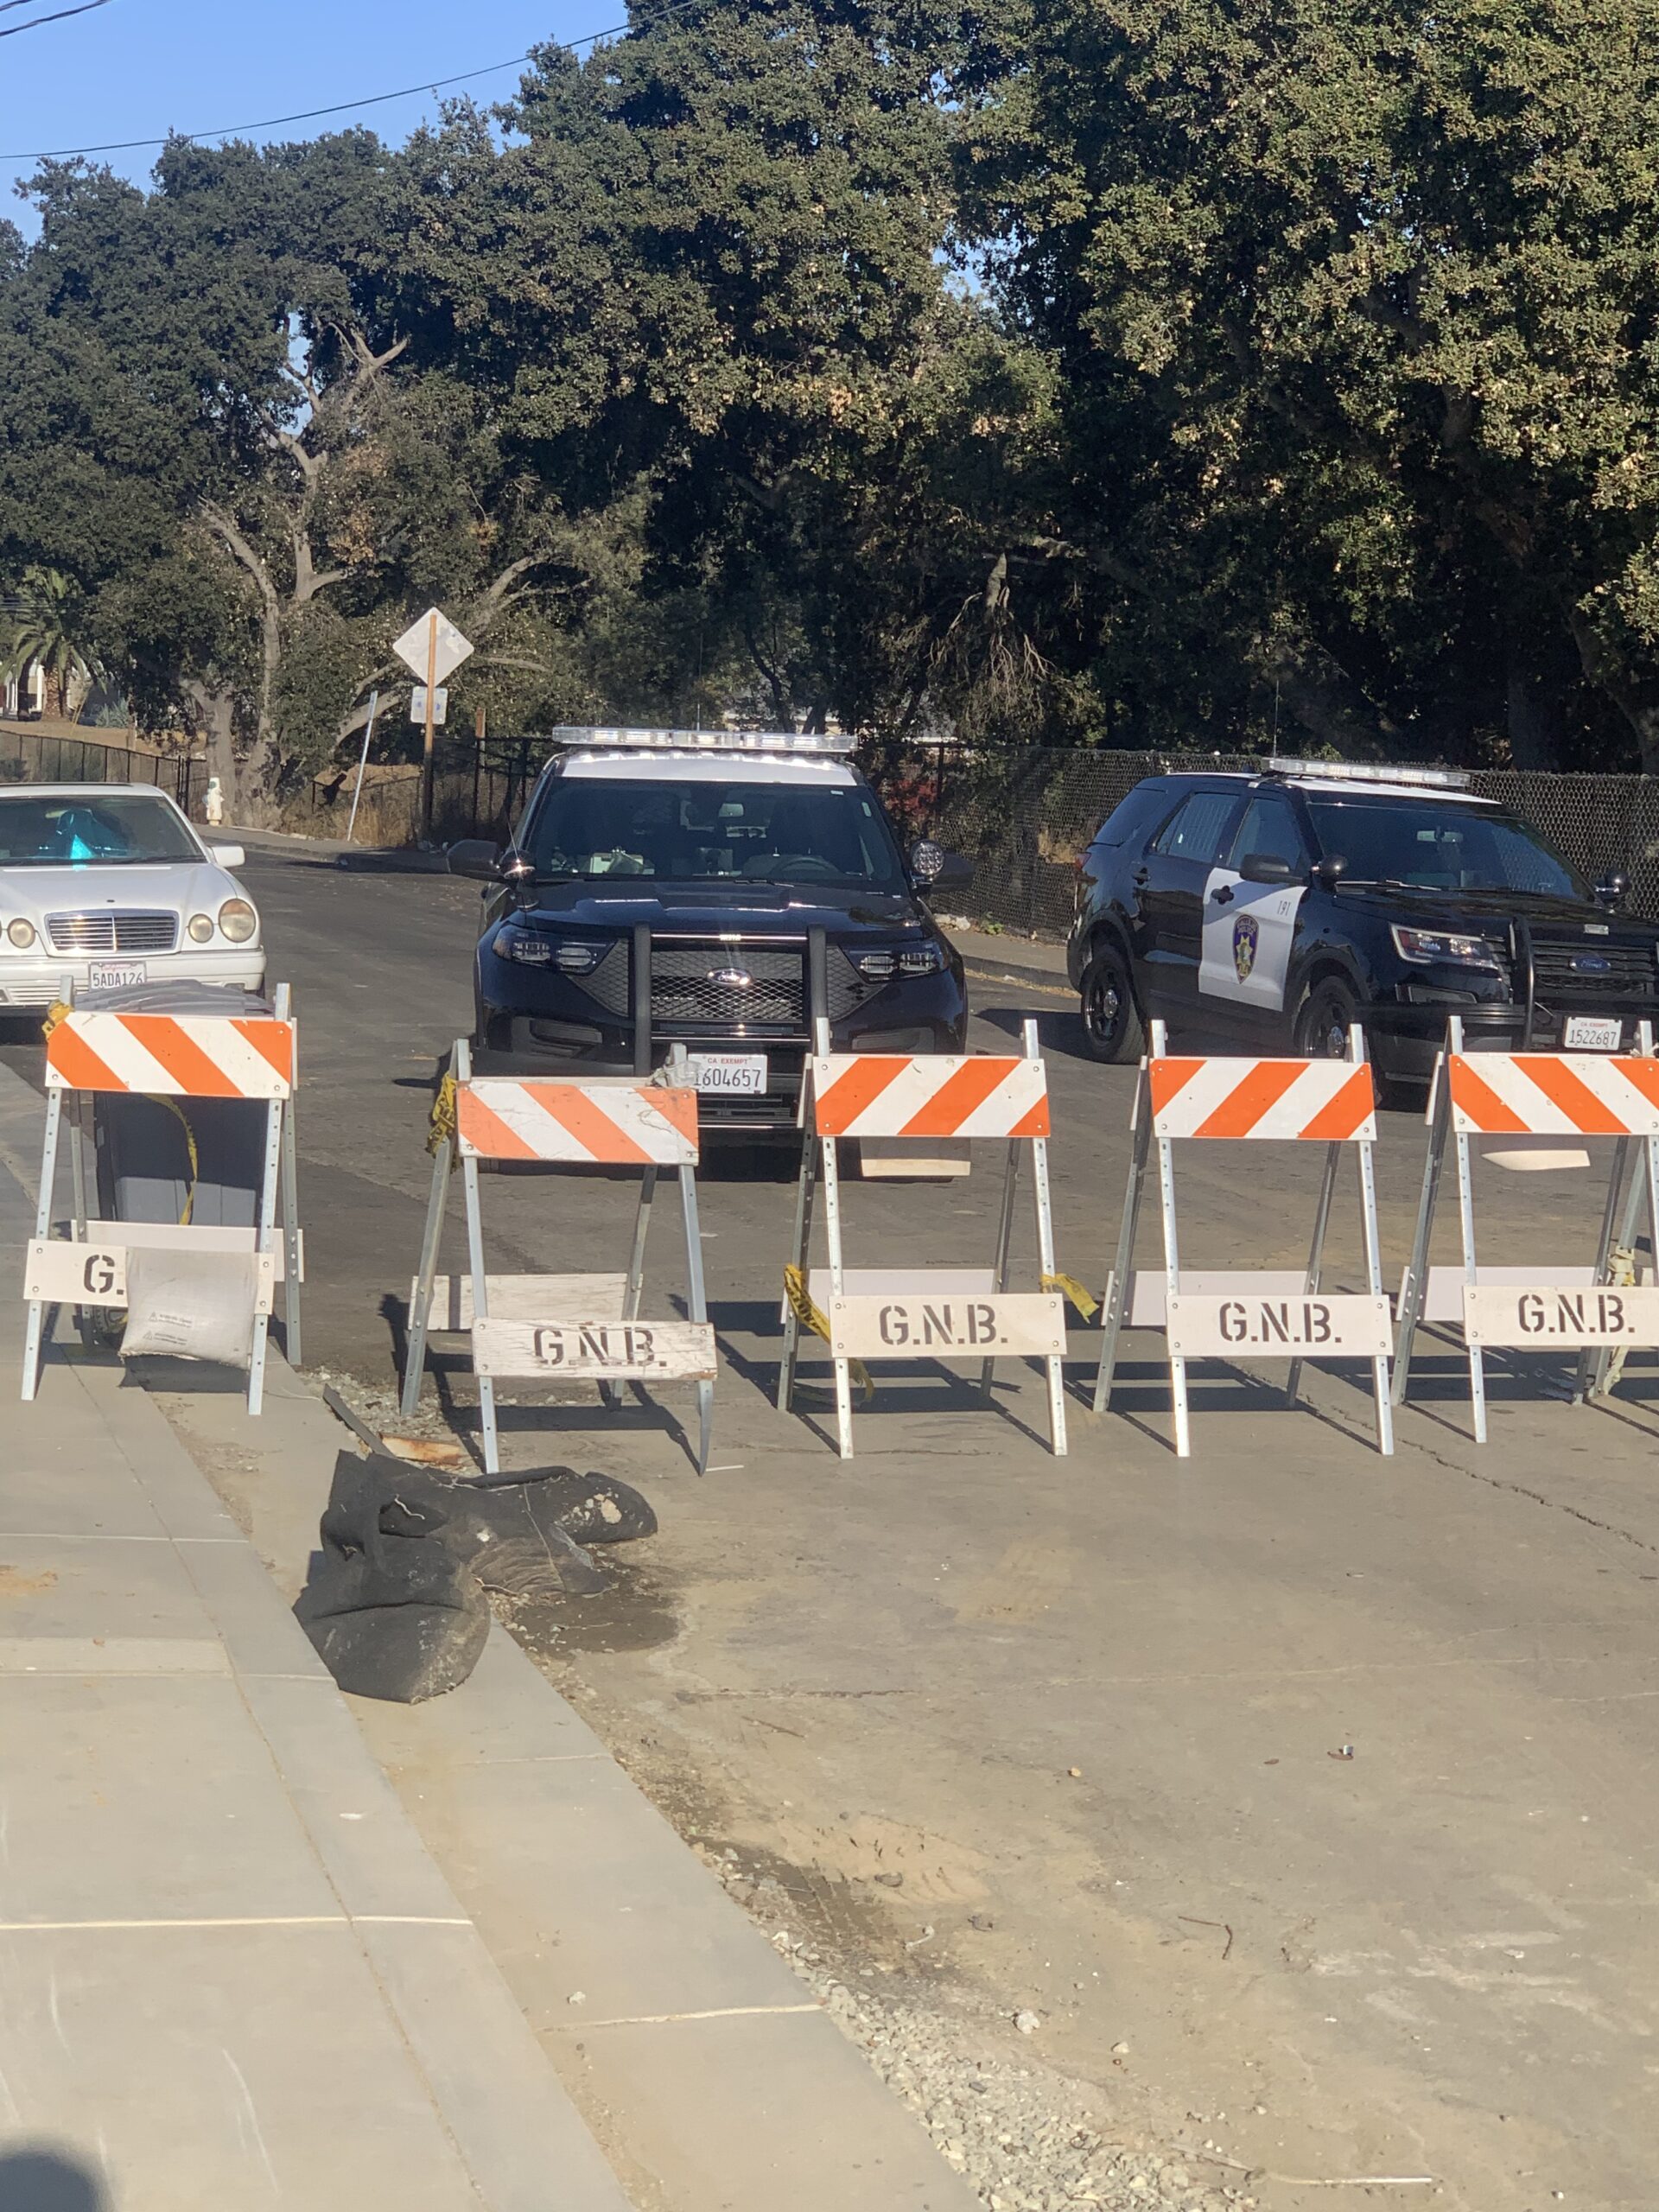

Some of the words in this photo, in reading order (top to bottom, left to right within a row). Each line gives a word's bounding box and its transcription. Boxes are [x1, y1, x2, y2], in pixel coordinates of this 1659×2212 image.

[1277, 900, 1292, 916] 191
[92, 972, 143, 987] 5ADA126
[1569, 1029, 1617, 1046] 1522687
[879, 1304, 1008, 1345] G.N.B.
[1219, 1302, 1342, 1343] G.N.B.
[1518, 1294, 1636, 1333] G.N.B.
